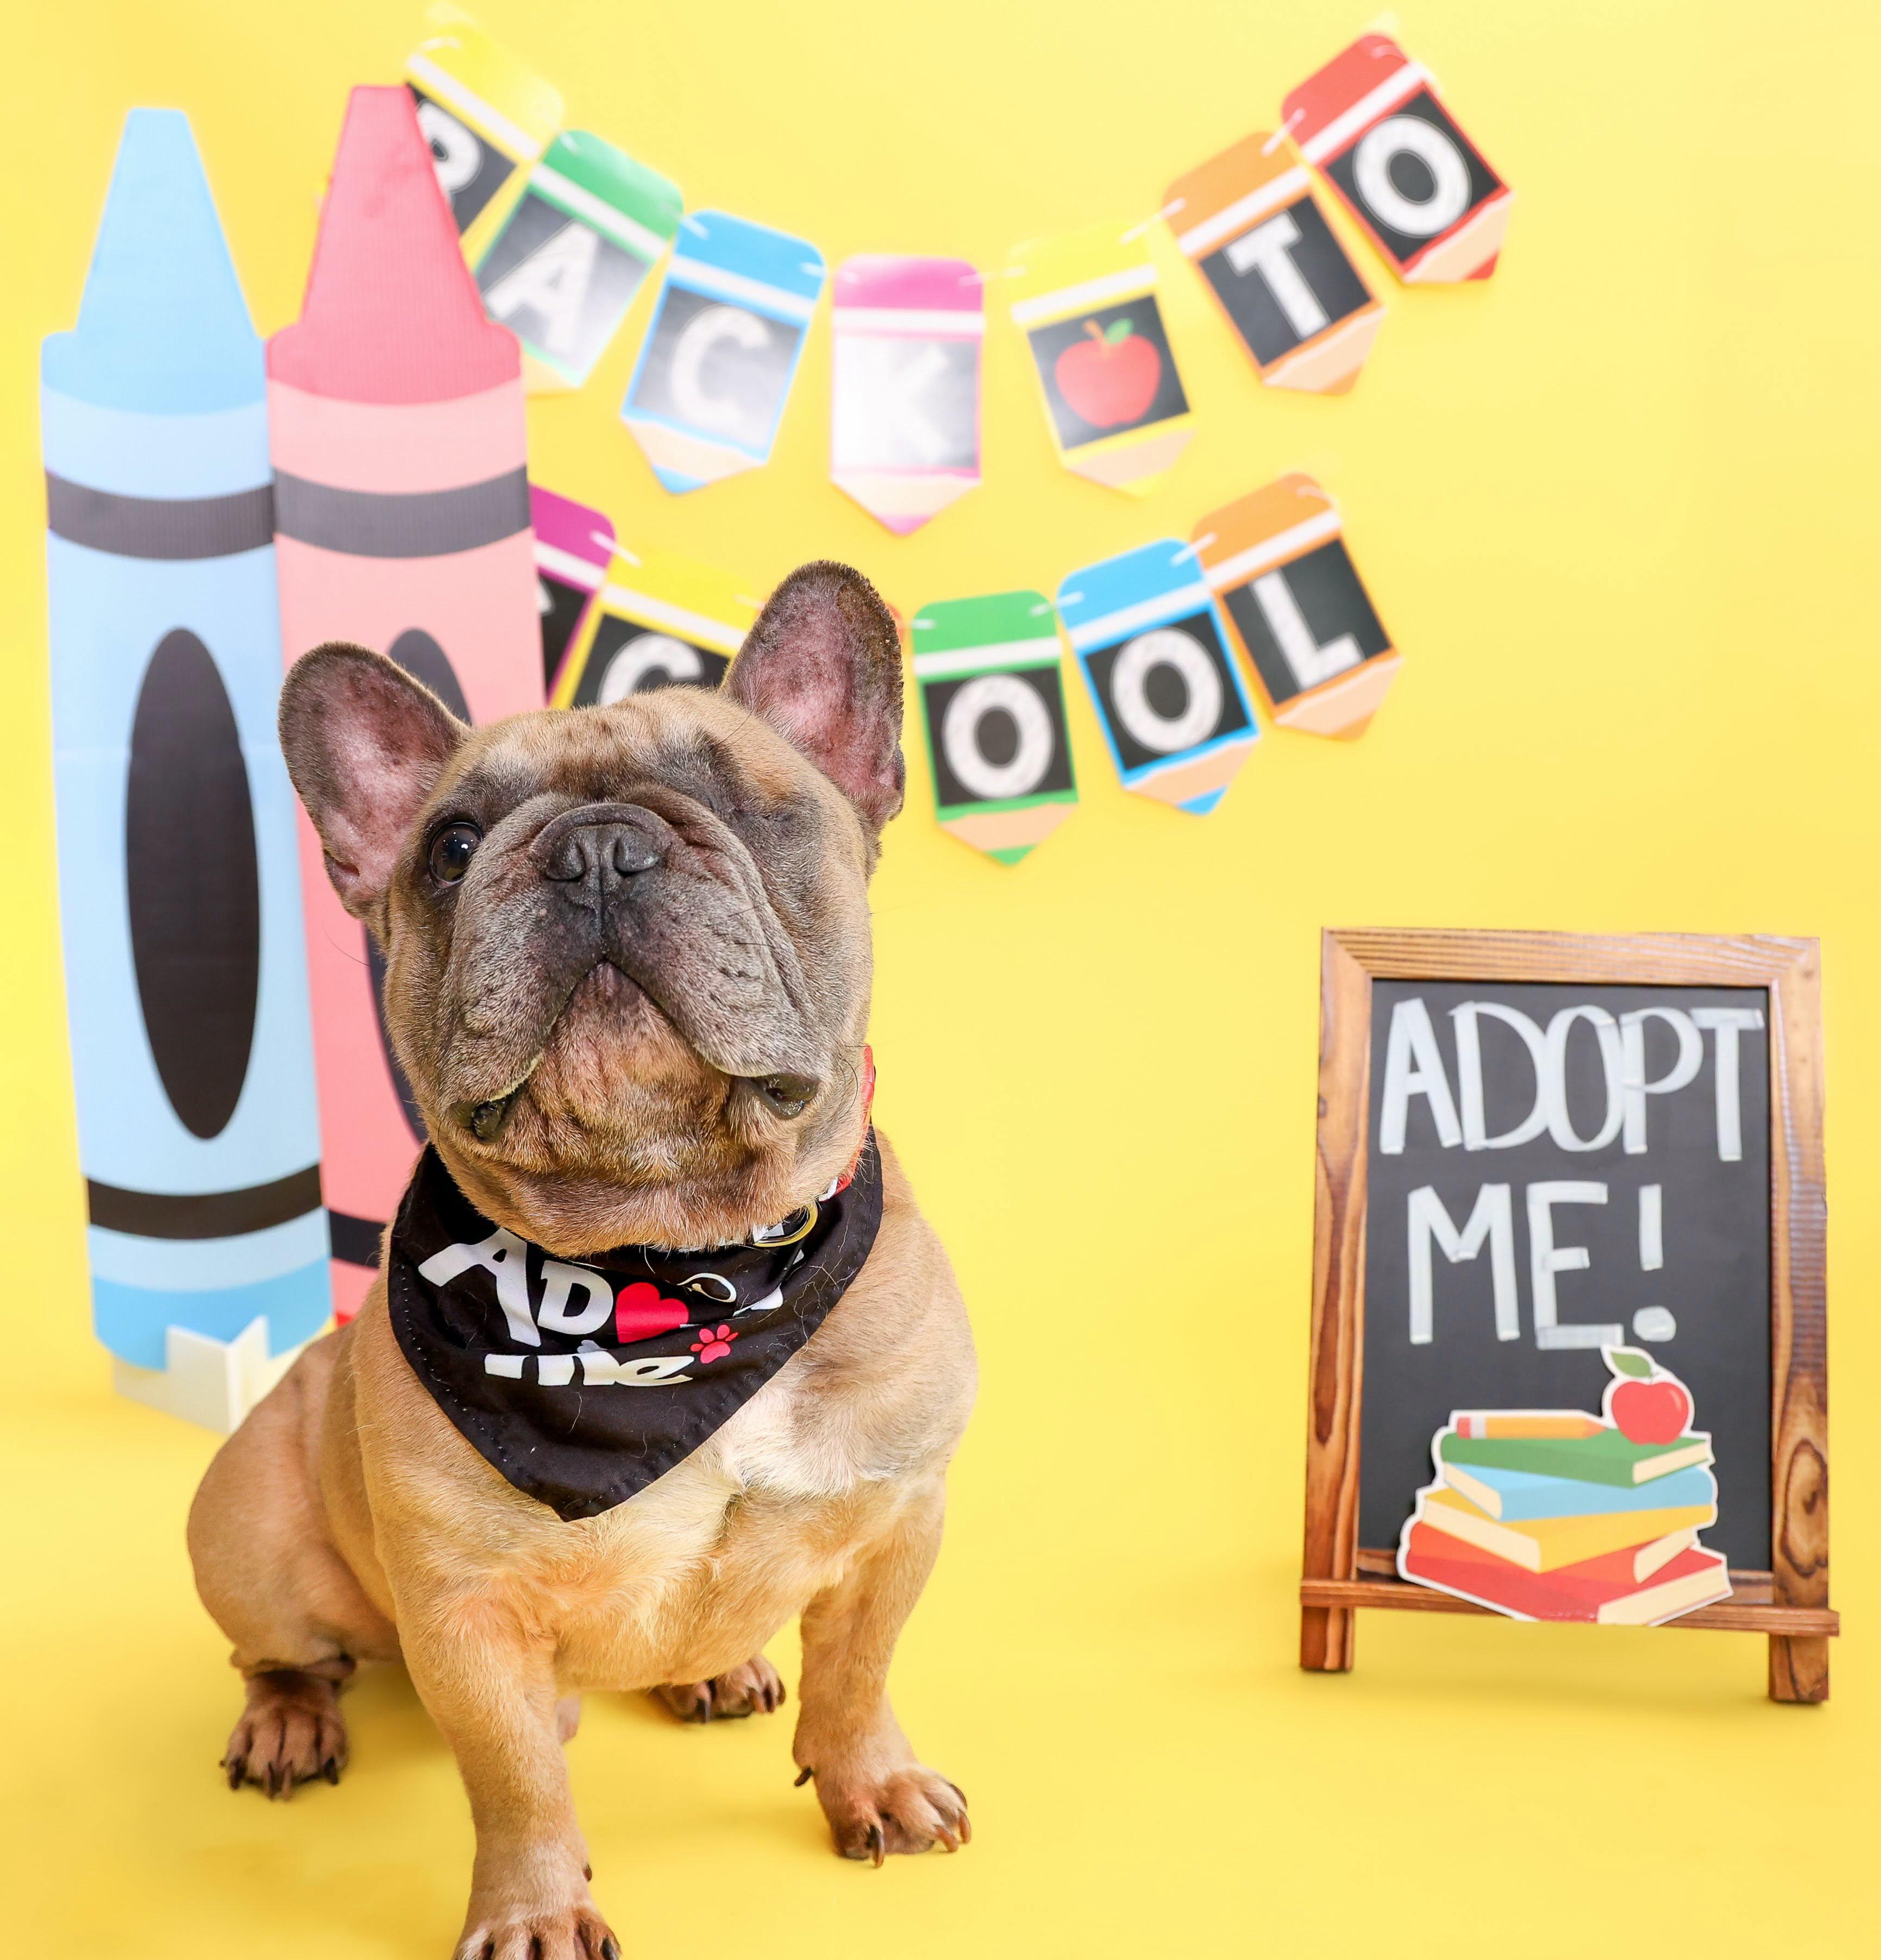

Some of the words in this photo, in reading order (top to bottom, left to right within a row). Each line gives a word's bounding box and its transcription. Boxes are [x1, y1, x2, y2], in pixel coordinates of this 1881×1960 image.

[1221, 114, 1471, 341] TO
[1379, 997, 1765, 1161] ADOPT
[1407, 1180, 1677, 1350] ME!
